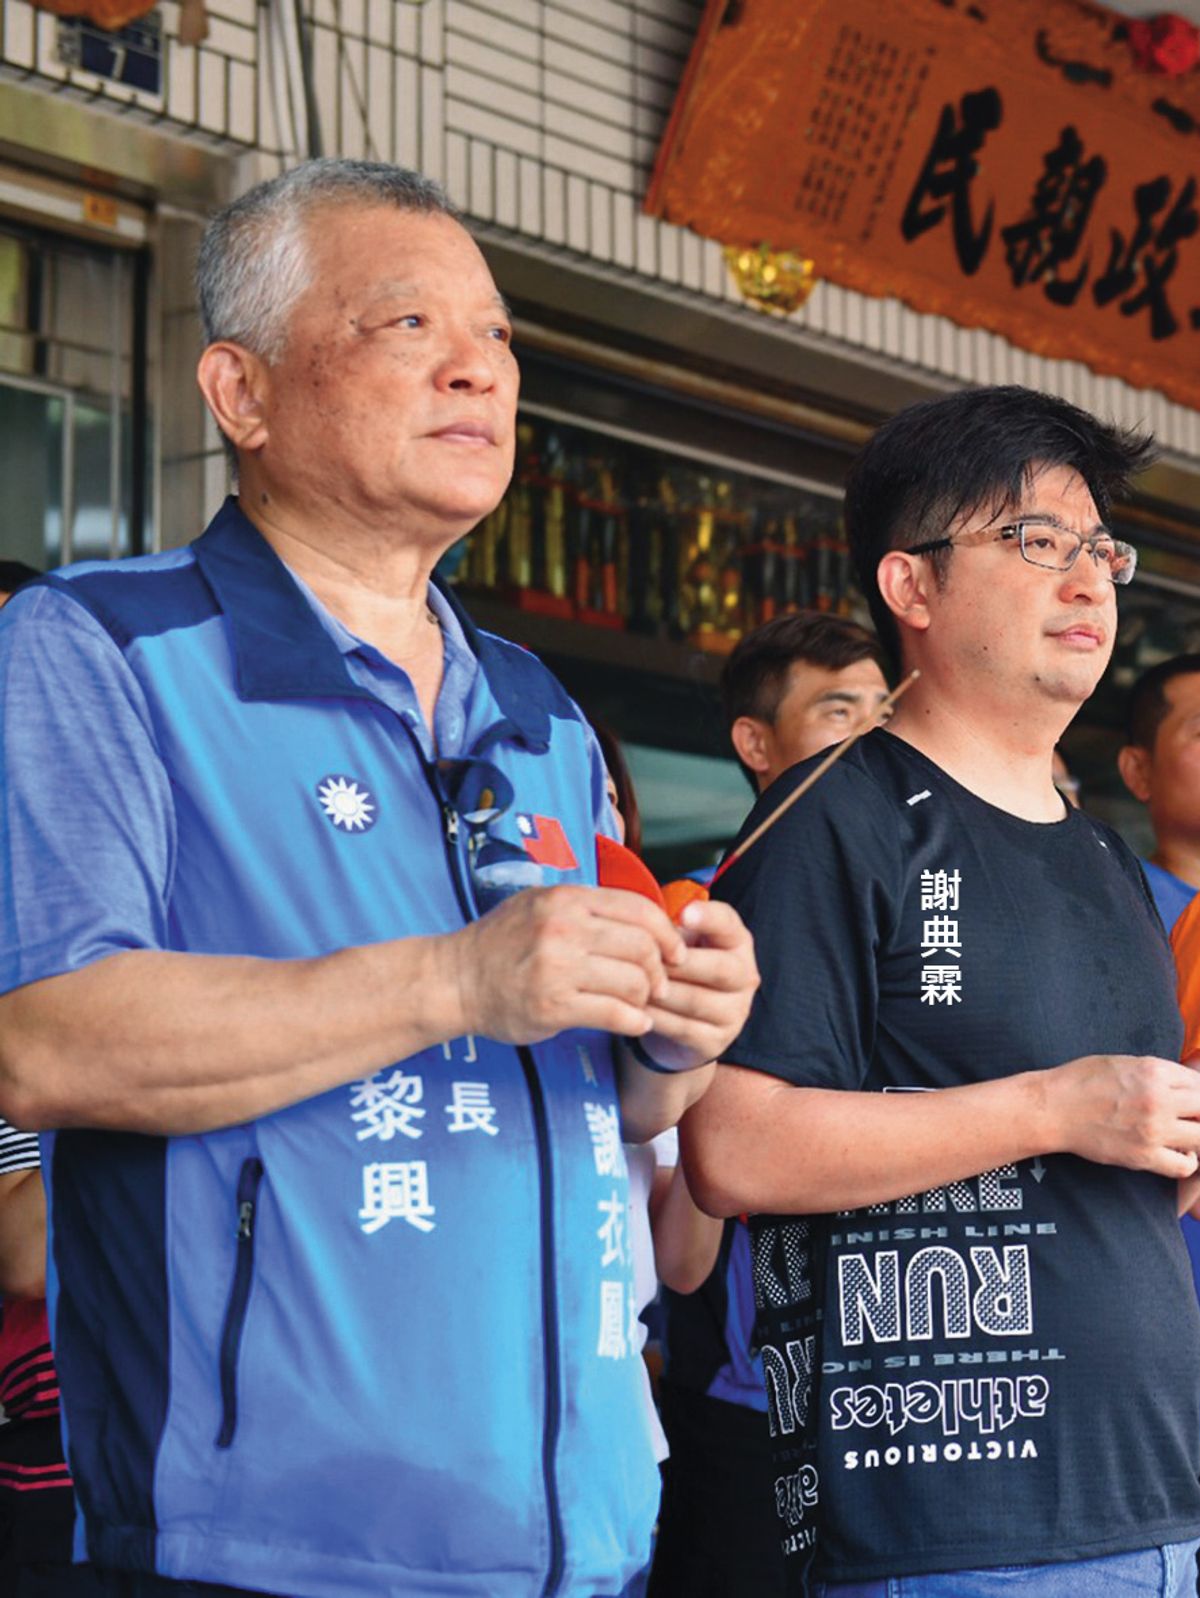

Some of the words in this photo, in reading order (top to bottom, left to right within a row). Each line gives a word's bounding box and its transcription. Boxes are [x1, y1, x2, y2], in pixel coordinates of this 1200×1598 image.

[964, 1222, 1058, 1238] LINE
[837, 1243, 1034, 1347] RUN
[883, 1352, 922, 1368] IS
[932, 1347, 1067, 1366] THERE
[830, 1374, 1050, 1436] athletes
[843, 1438, 1038, 1470] VICTORIOUS
